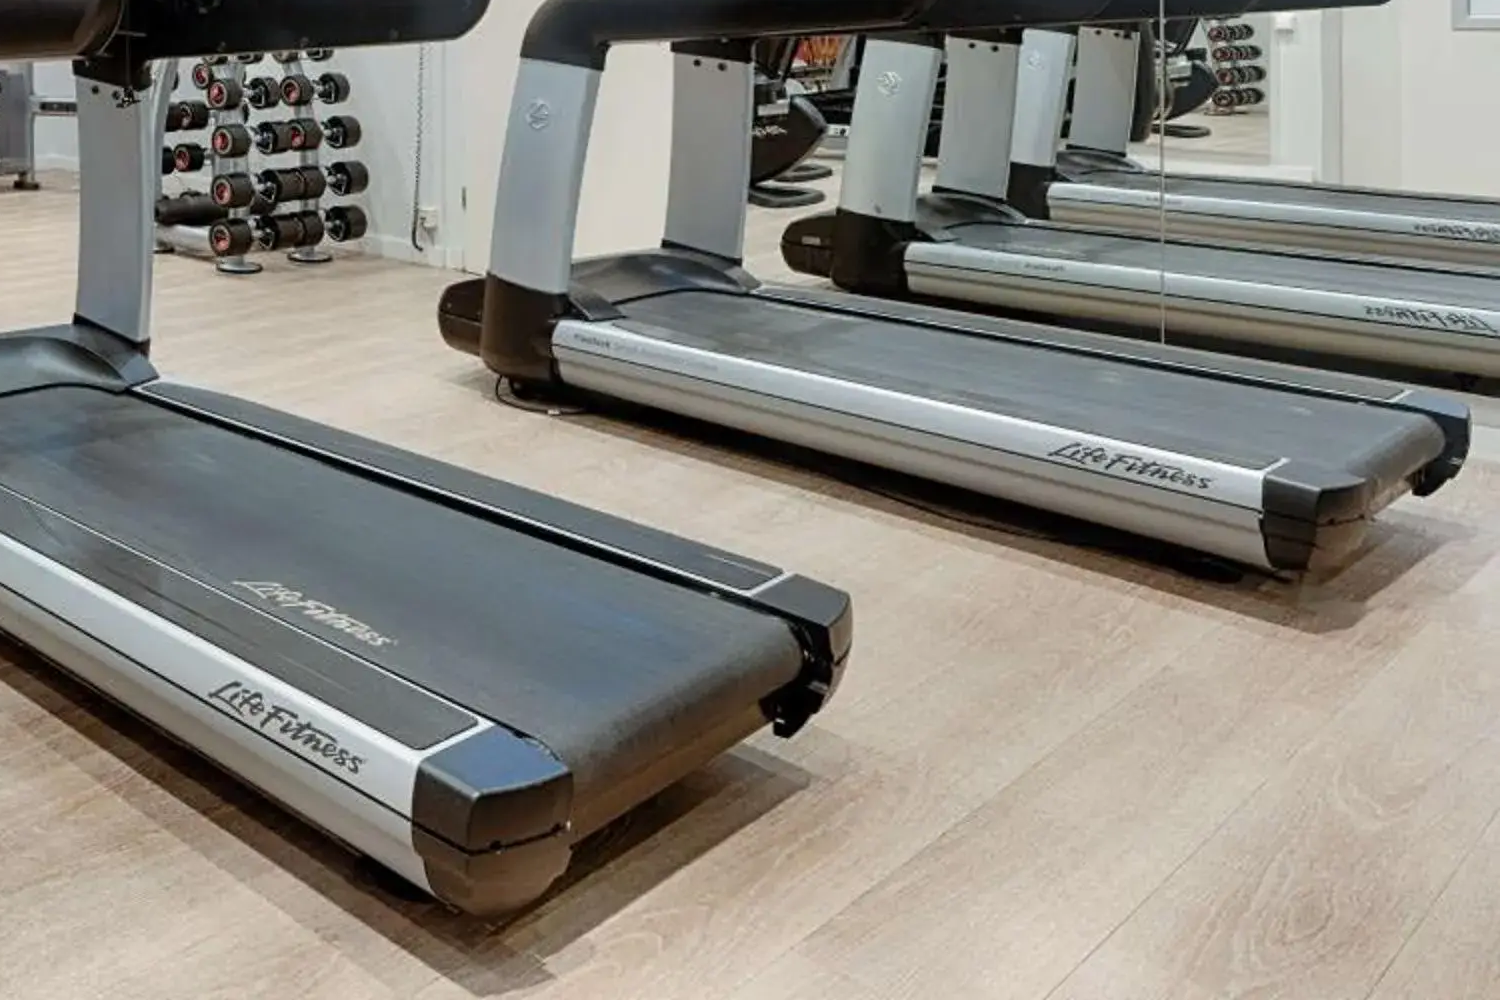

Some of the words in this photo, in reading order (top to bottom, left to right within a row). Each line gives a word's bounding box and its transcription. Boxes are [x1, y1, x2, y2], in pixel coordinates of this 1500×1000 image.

[1047, 442, 1108, 464] Life
[1104, 453, 1214, 489] Fitness
[231, 580, 303, 603] Life
[281, 600, 392, 646] Fitness
[208, 681, 265, 717] Life
[260, 705, 365, 775] Fitness
